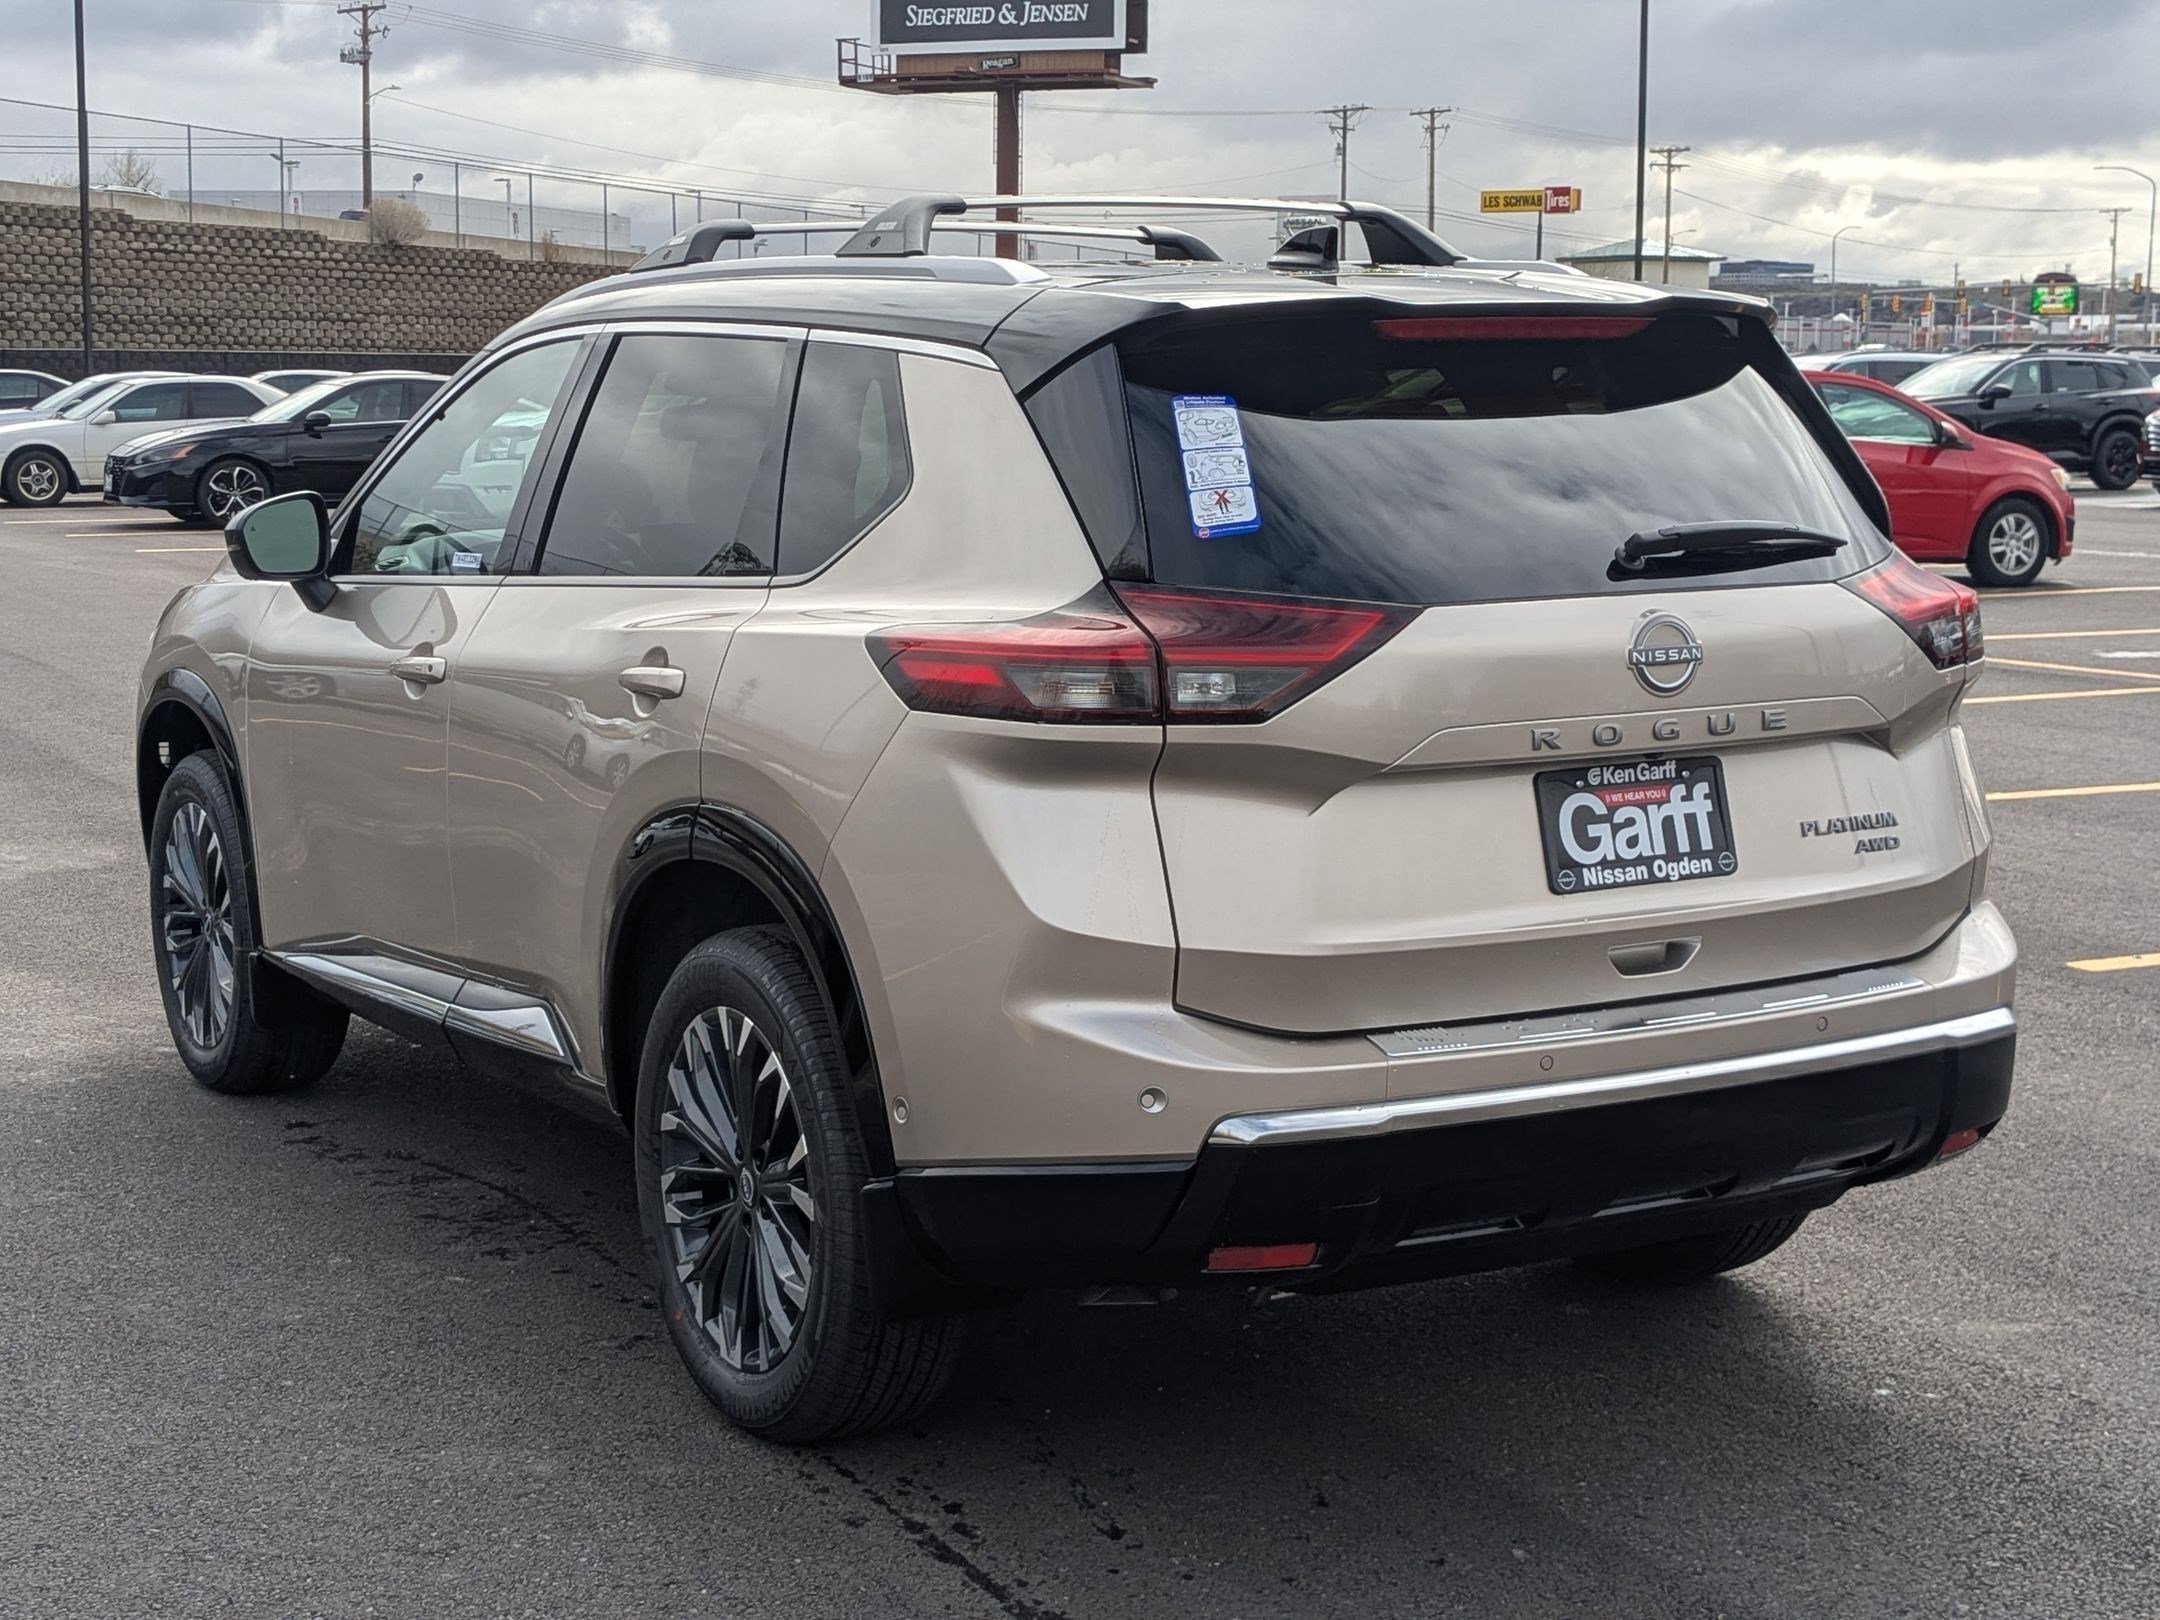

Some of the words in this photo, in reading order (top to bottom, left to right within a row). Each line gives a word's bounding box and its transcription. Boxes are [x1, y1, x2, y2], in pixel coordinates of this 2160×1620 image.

[905, 4, 996, 27] SIEGFRIED
[998, 3, 1019, 25] &
[1019, 1, 1089, 26] JENSEN
[982, 58, 1014, 70] Reagan
[1483, 195, 1501, 209] LES
[1502, 194, 1543, 208] SCHWAB
[1545, 189, 1570, 212] Tires
[1632, 647, 1702, 663] NISSAN
[1531, 708, 1788, 751] ROGUE
[1602, 765, 1636, 785] Ken
[1636, 759, 1676, 782] Garff
[1610, 792, 1624, 802] WE
[1624, 789, 1646, 801] HEAR
[1645, 788, 1662, 799] YOU
[1558, 781, 1714, 865] Garff
[1800, 811, 1898, 838] PLATINUM
[1854, 836, 1901, 854] AWD
[1582, 865, 1648, 887] Nissan
[1652, 856, 1713, 881] Ogden
